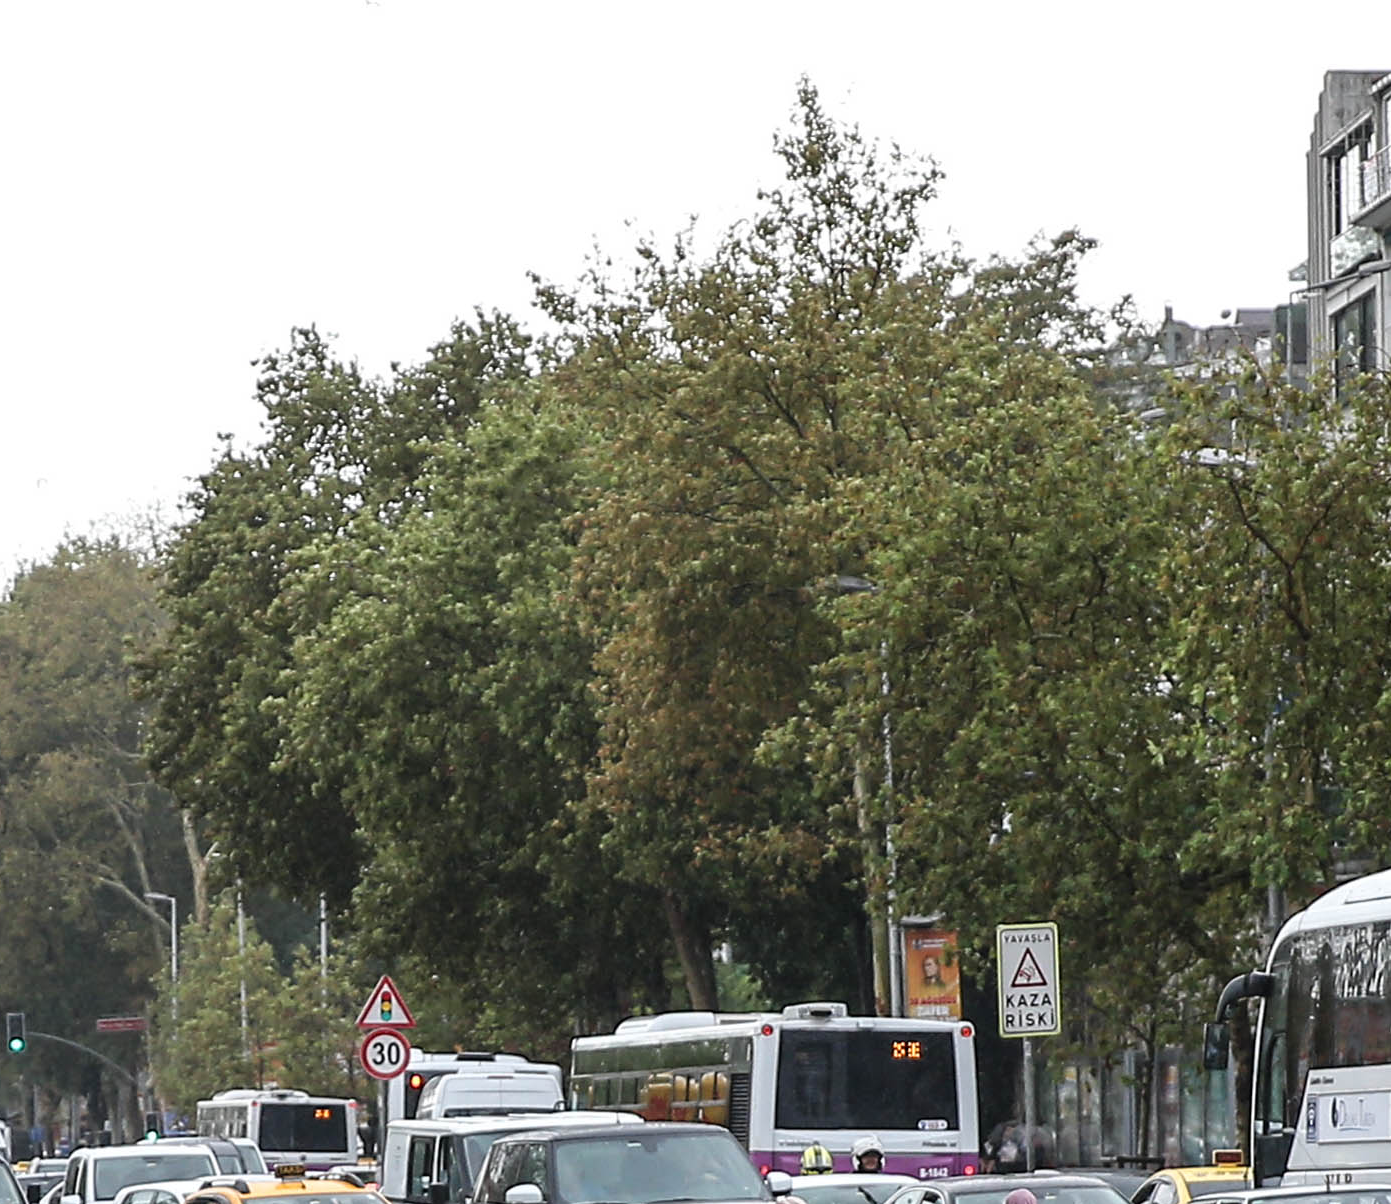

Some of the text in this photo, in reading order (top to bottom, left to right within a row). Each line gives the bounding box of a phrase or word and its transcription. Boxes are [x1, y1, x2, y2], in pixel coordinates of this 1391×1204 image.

[1004, 933, 1051, 943] YAVAŞLA
[1005, 993, 1052, 1008] KAZA
[1005, 1008, 1055, 1028] RİSKİ
[372, 1042, 400, 1065] 30
